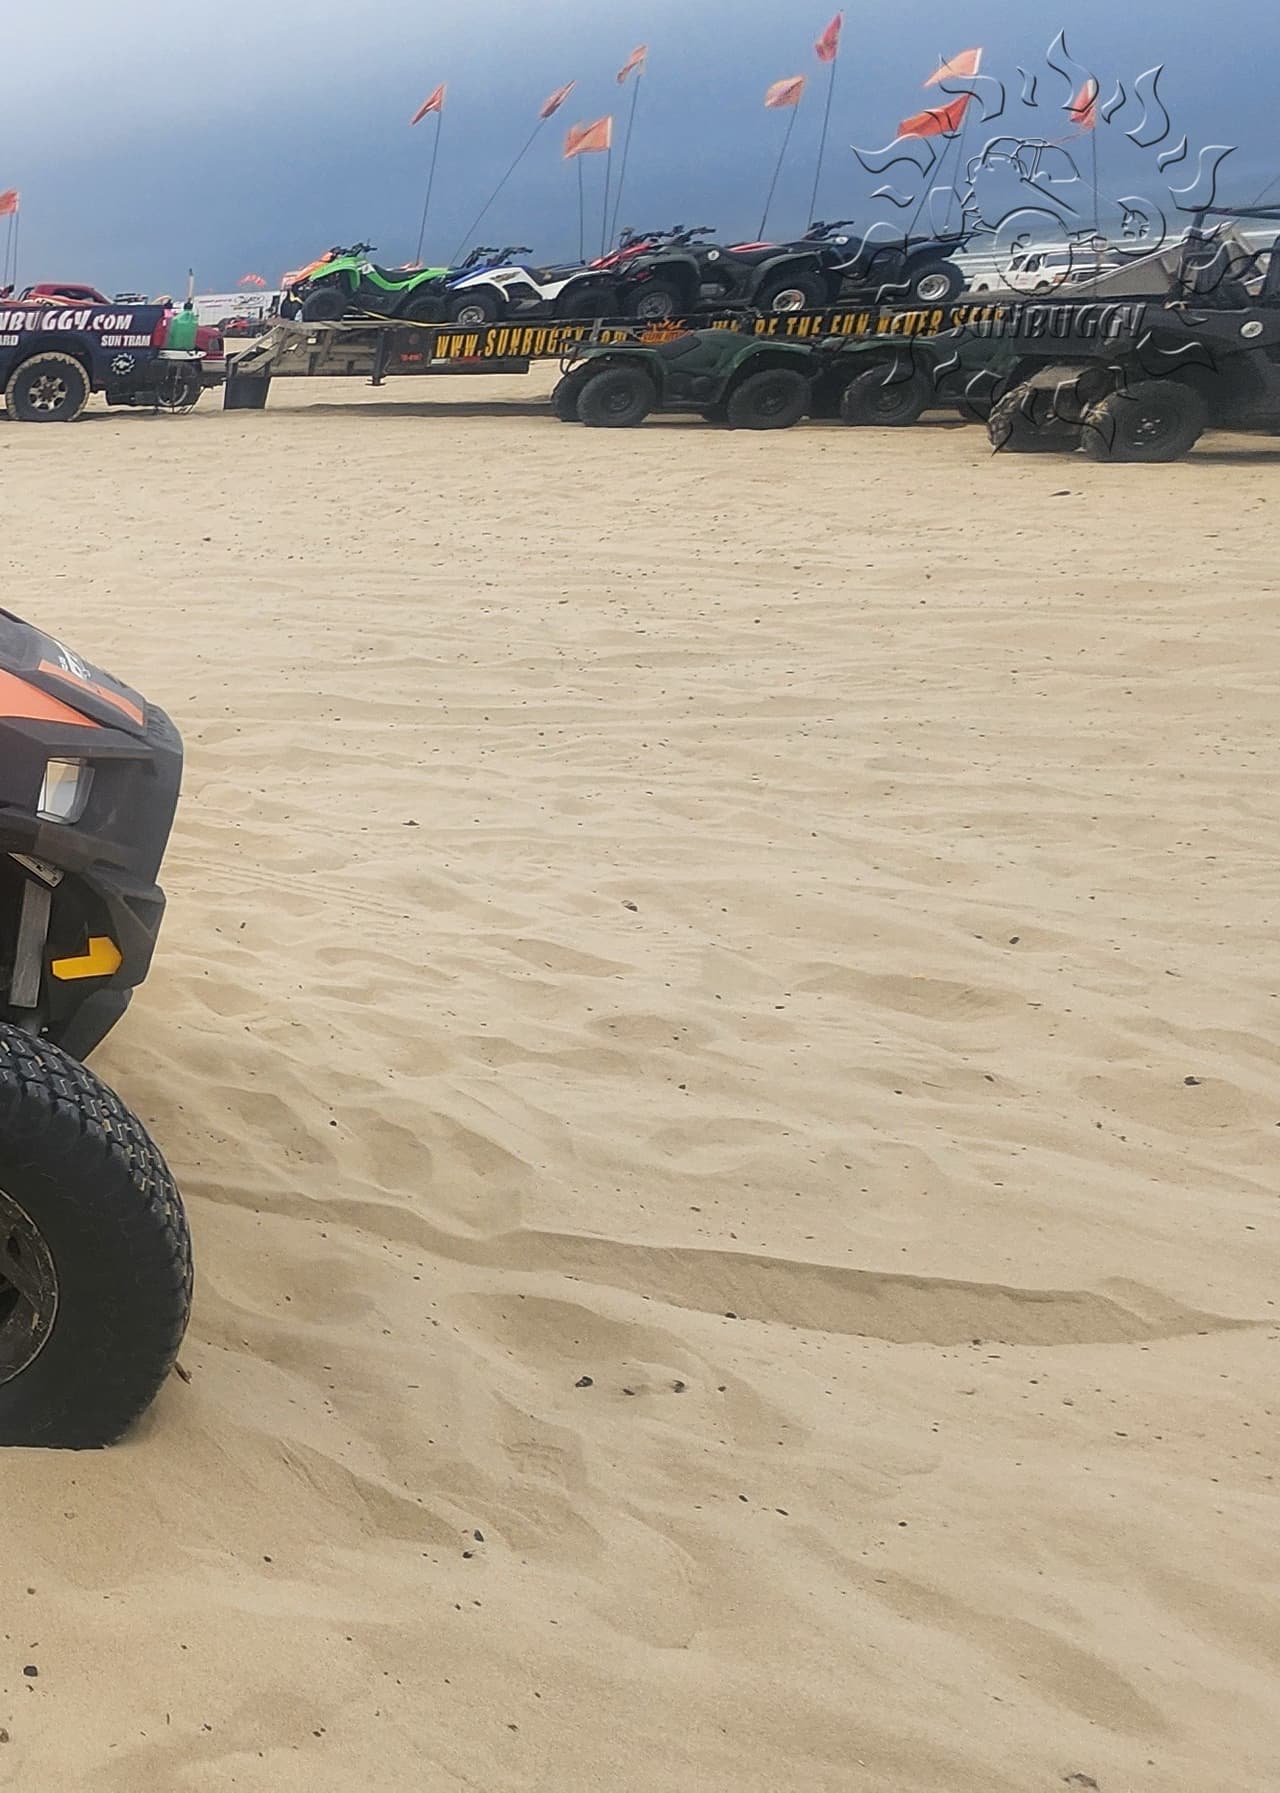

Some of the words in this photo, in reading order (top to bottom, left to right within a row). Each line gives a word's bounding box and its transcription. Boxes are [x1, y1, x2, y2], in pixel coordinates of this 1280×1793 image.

[786, 316, 823, 337] THE
[101, 335, 123, 347] SUN
[125, 335, 151, 347] TRAM
